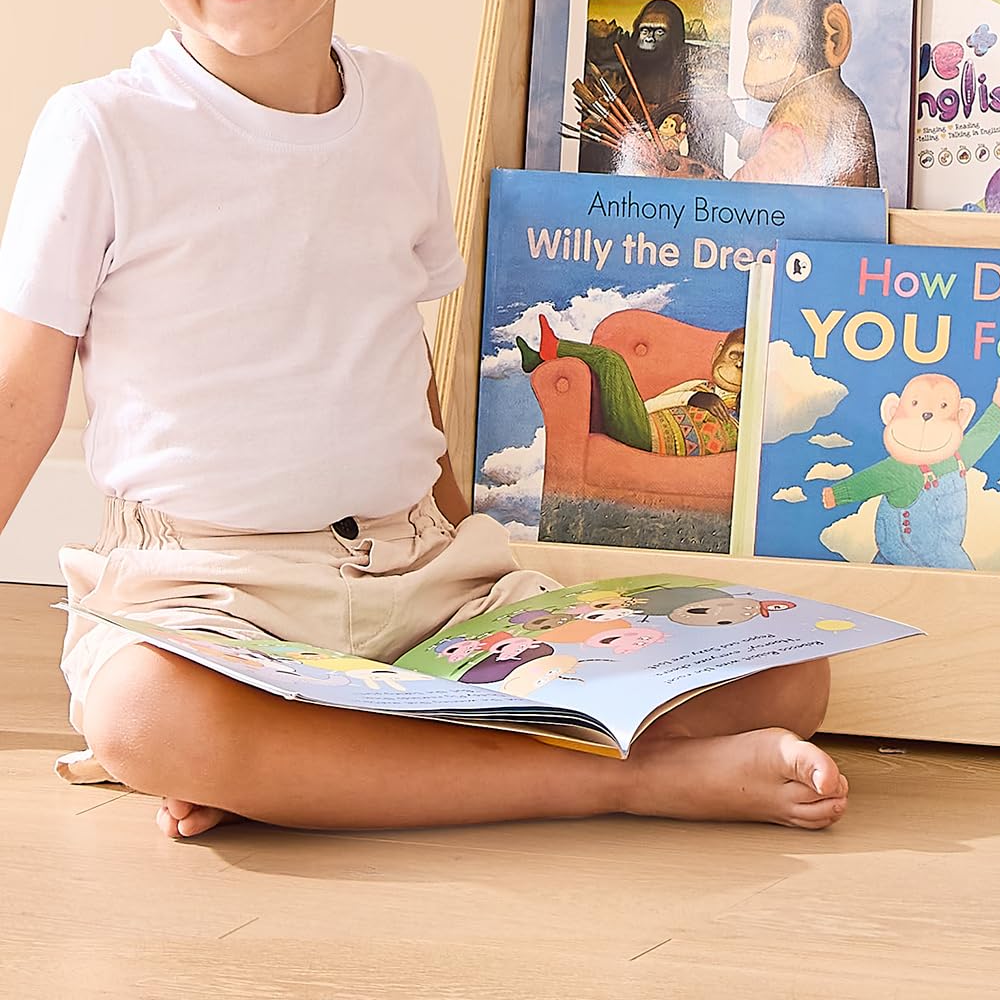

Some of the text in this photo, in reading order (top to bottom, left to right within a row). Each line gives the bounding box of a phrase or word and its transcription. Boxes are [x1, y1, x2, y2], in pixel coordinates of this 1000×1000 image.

[587, 191, 786, 228] Anthony Browne
[526, 227, 613, 270] Willy
[622, 233, 679, 267] the
[858, 257, 957, 299] How
[800, 309, 951, 364] YOU
